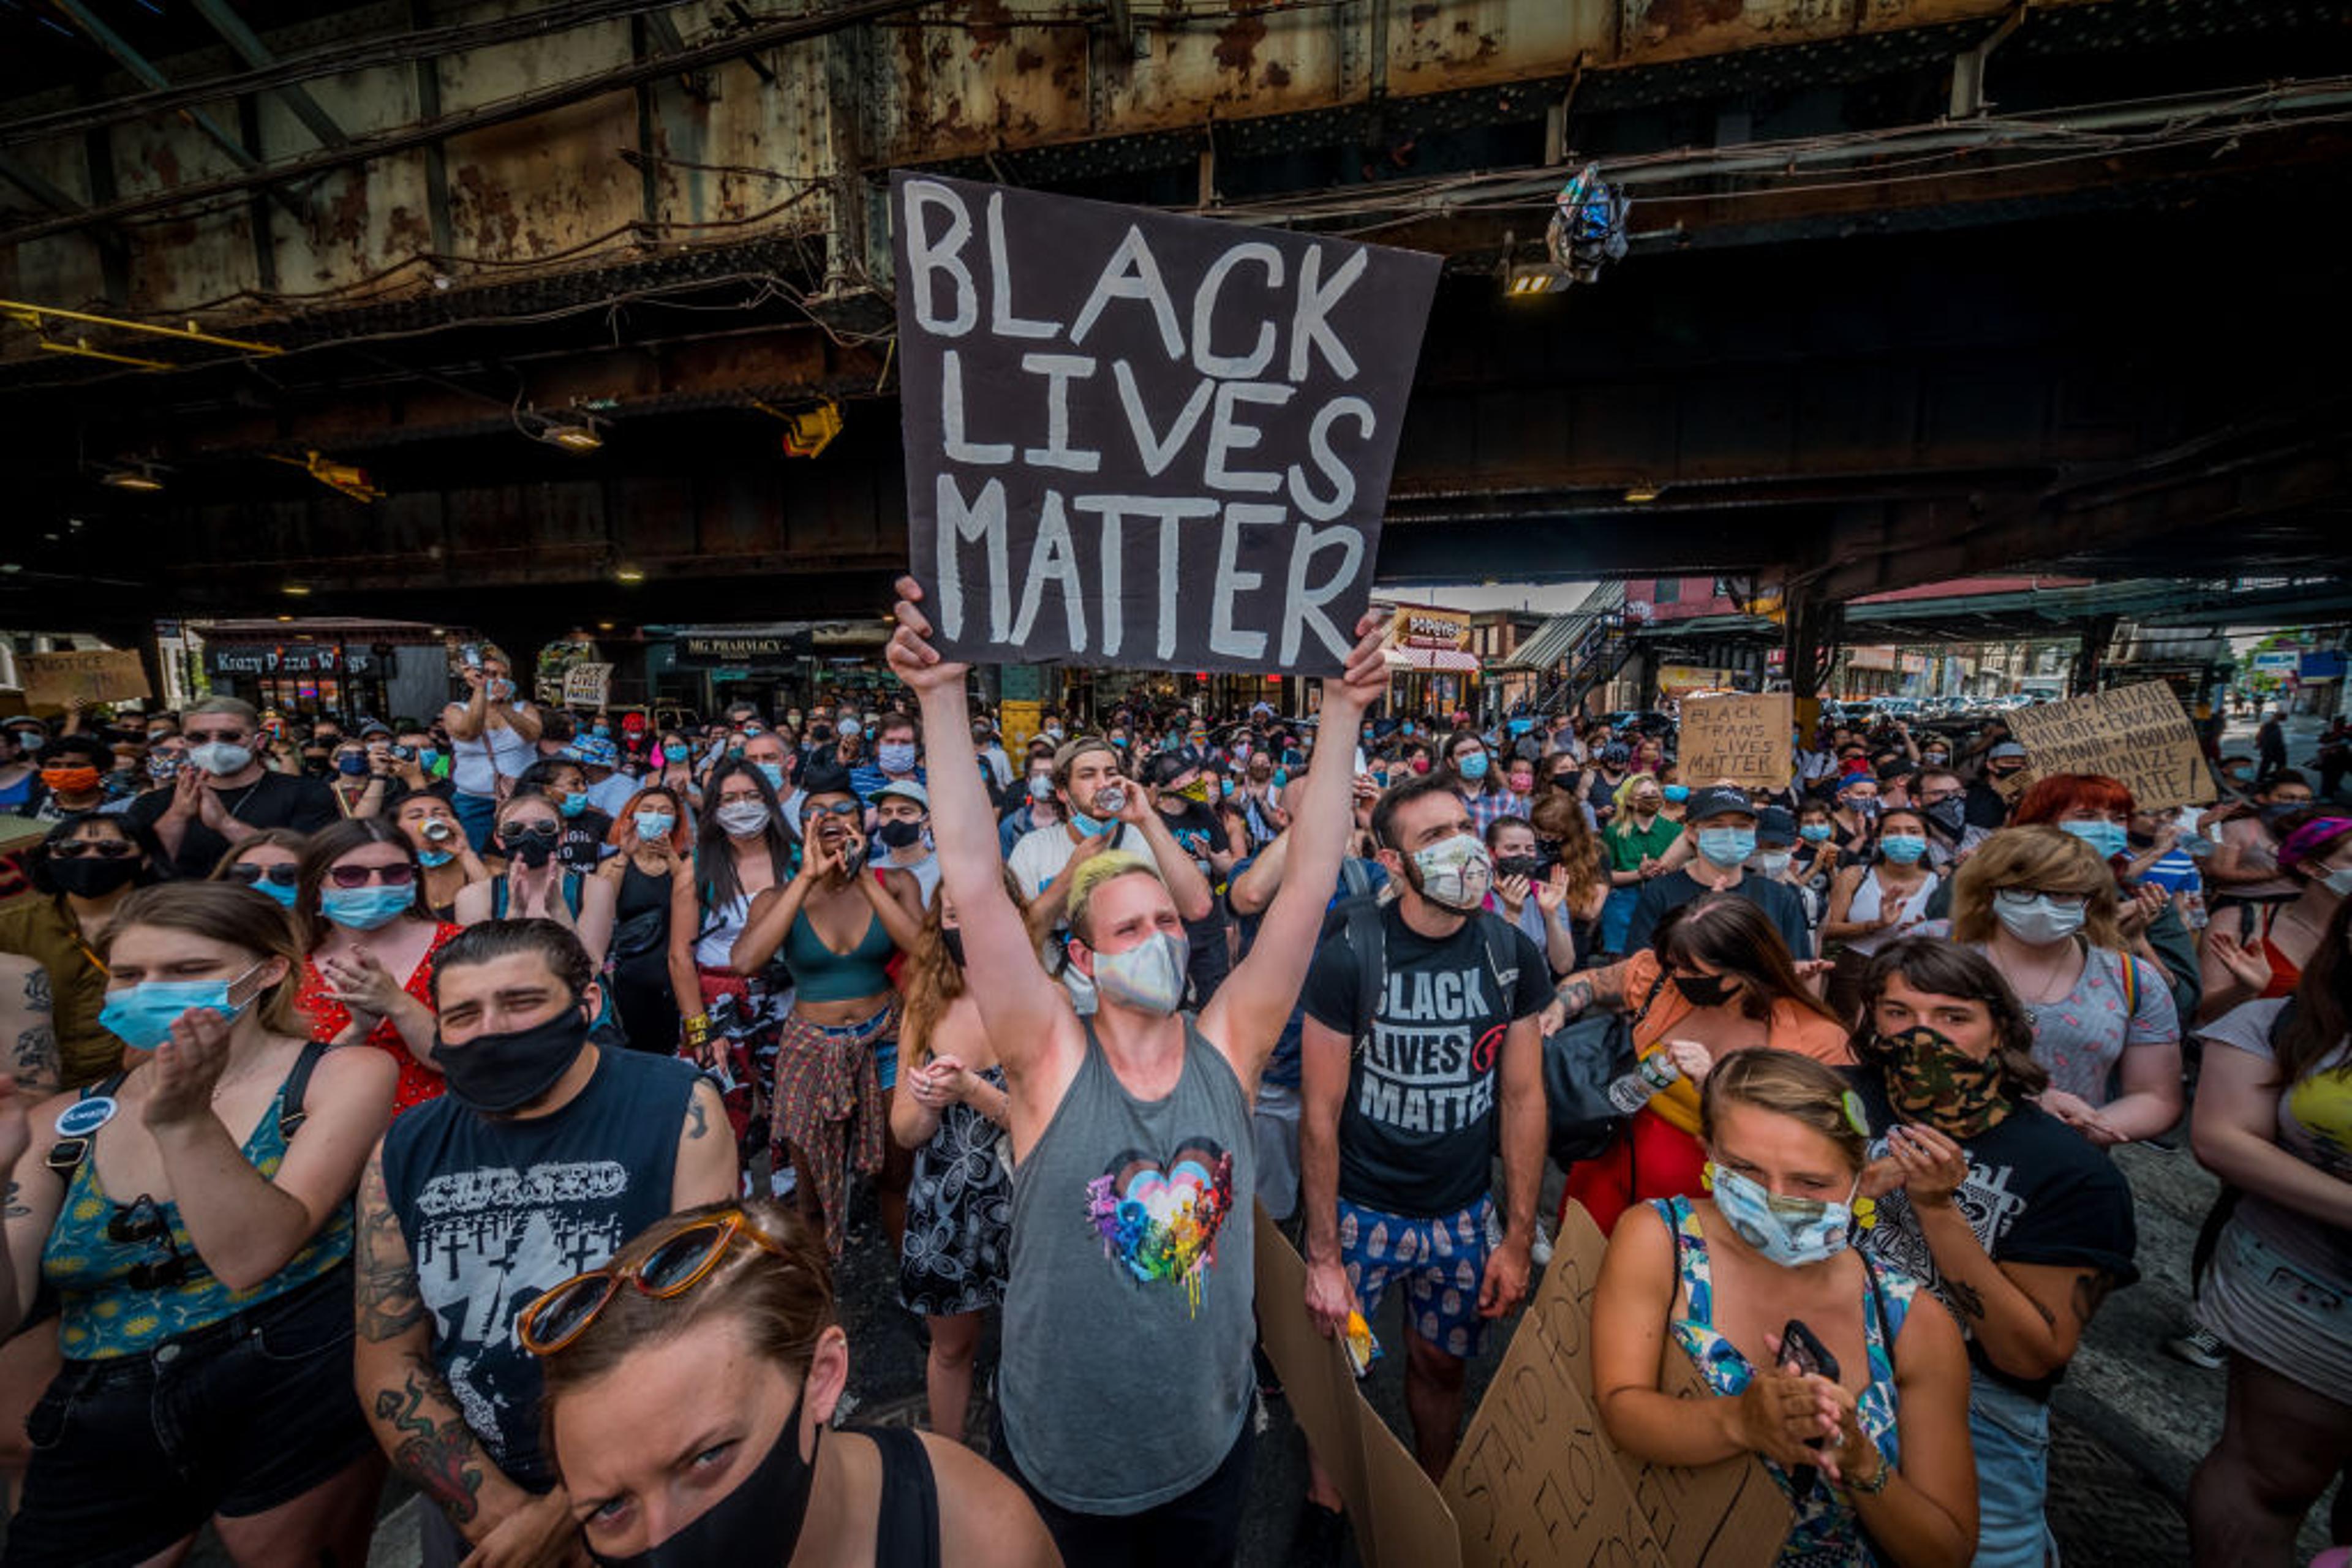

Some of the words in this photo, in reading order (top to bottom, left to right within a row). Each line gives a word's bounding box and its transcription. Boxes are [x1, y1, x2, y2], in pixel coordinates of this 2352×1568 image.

[903, 179, 1370, 382] BLACK
[942, 349, 1377, 522] LIVES
[936, 472, 1366, 666] MATTER
[712, 639, 781, 654] PHARMACY
[217, 652, 262, 673] Krazy
[1691, 704, 1761, 723] BLACK
[1697, 725, 1765, 738] TRANS
[1713, 739, 1774, 753] LIVES
[1688, 753, 1772, 774] MATTER
[1370, 1028, 1464, 1076] LIVES
